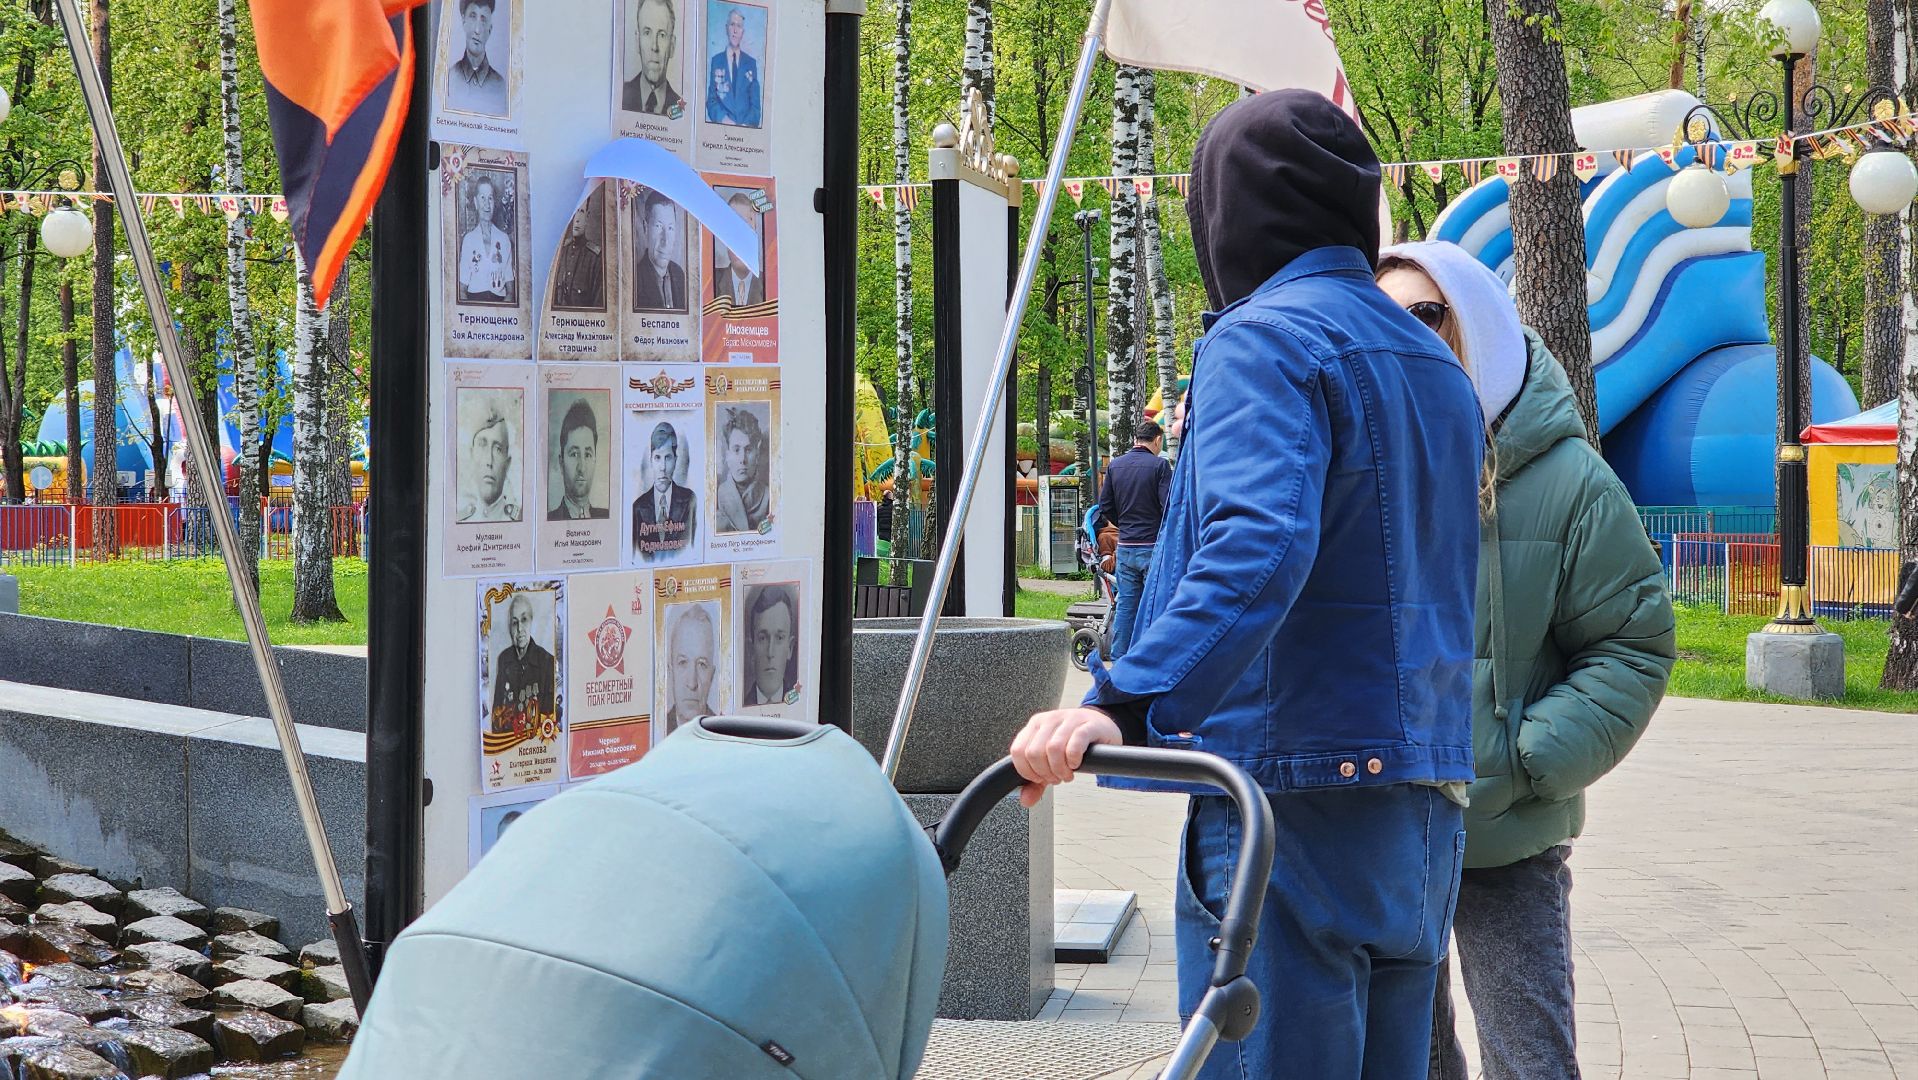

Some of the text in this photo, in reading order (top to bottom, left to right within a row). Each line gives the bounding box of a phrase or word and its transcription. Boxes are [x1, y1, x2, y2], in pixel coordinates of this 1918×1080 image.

[1576, 158, 1585, 171] 9
[458, 313, 519, 327] Тернющенко
[551, 316, 606, 329] Тернющенко
[641, 318, 680, 329] Беспалов
[452, 330, 525, 342] Зоя Александровна
[725, 323, 769, 337] Иноземцев
[544, 331, 613, 342] Александр Михайлович
[633, 335, 689, 346] Фёдор Иванович
[558, 345, 598, 353] старшина
[475, 534, 503, 542] Мулявин
[586, 676, 634, 694] БЕССМЕРТНЫЙ
[587, 690, 632, 708] ПОЛК РОССИИ
